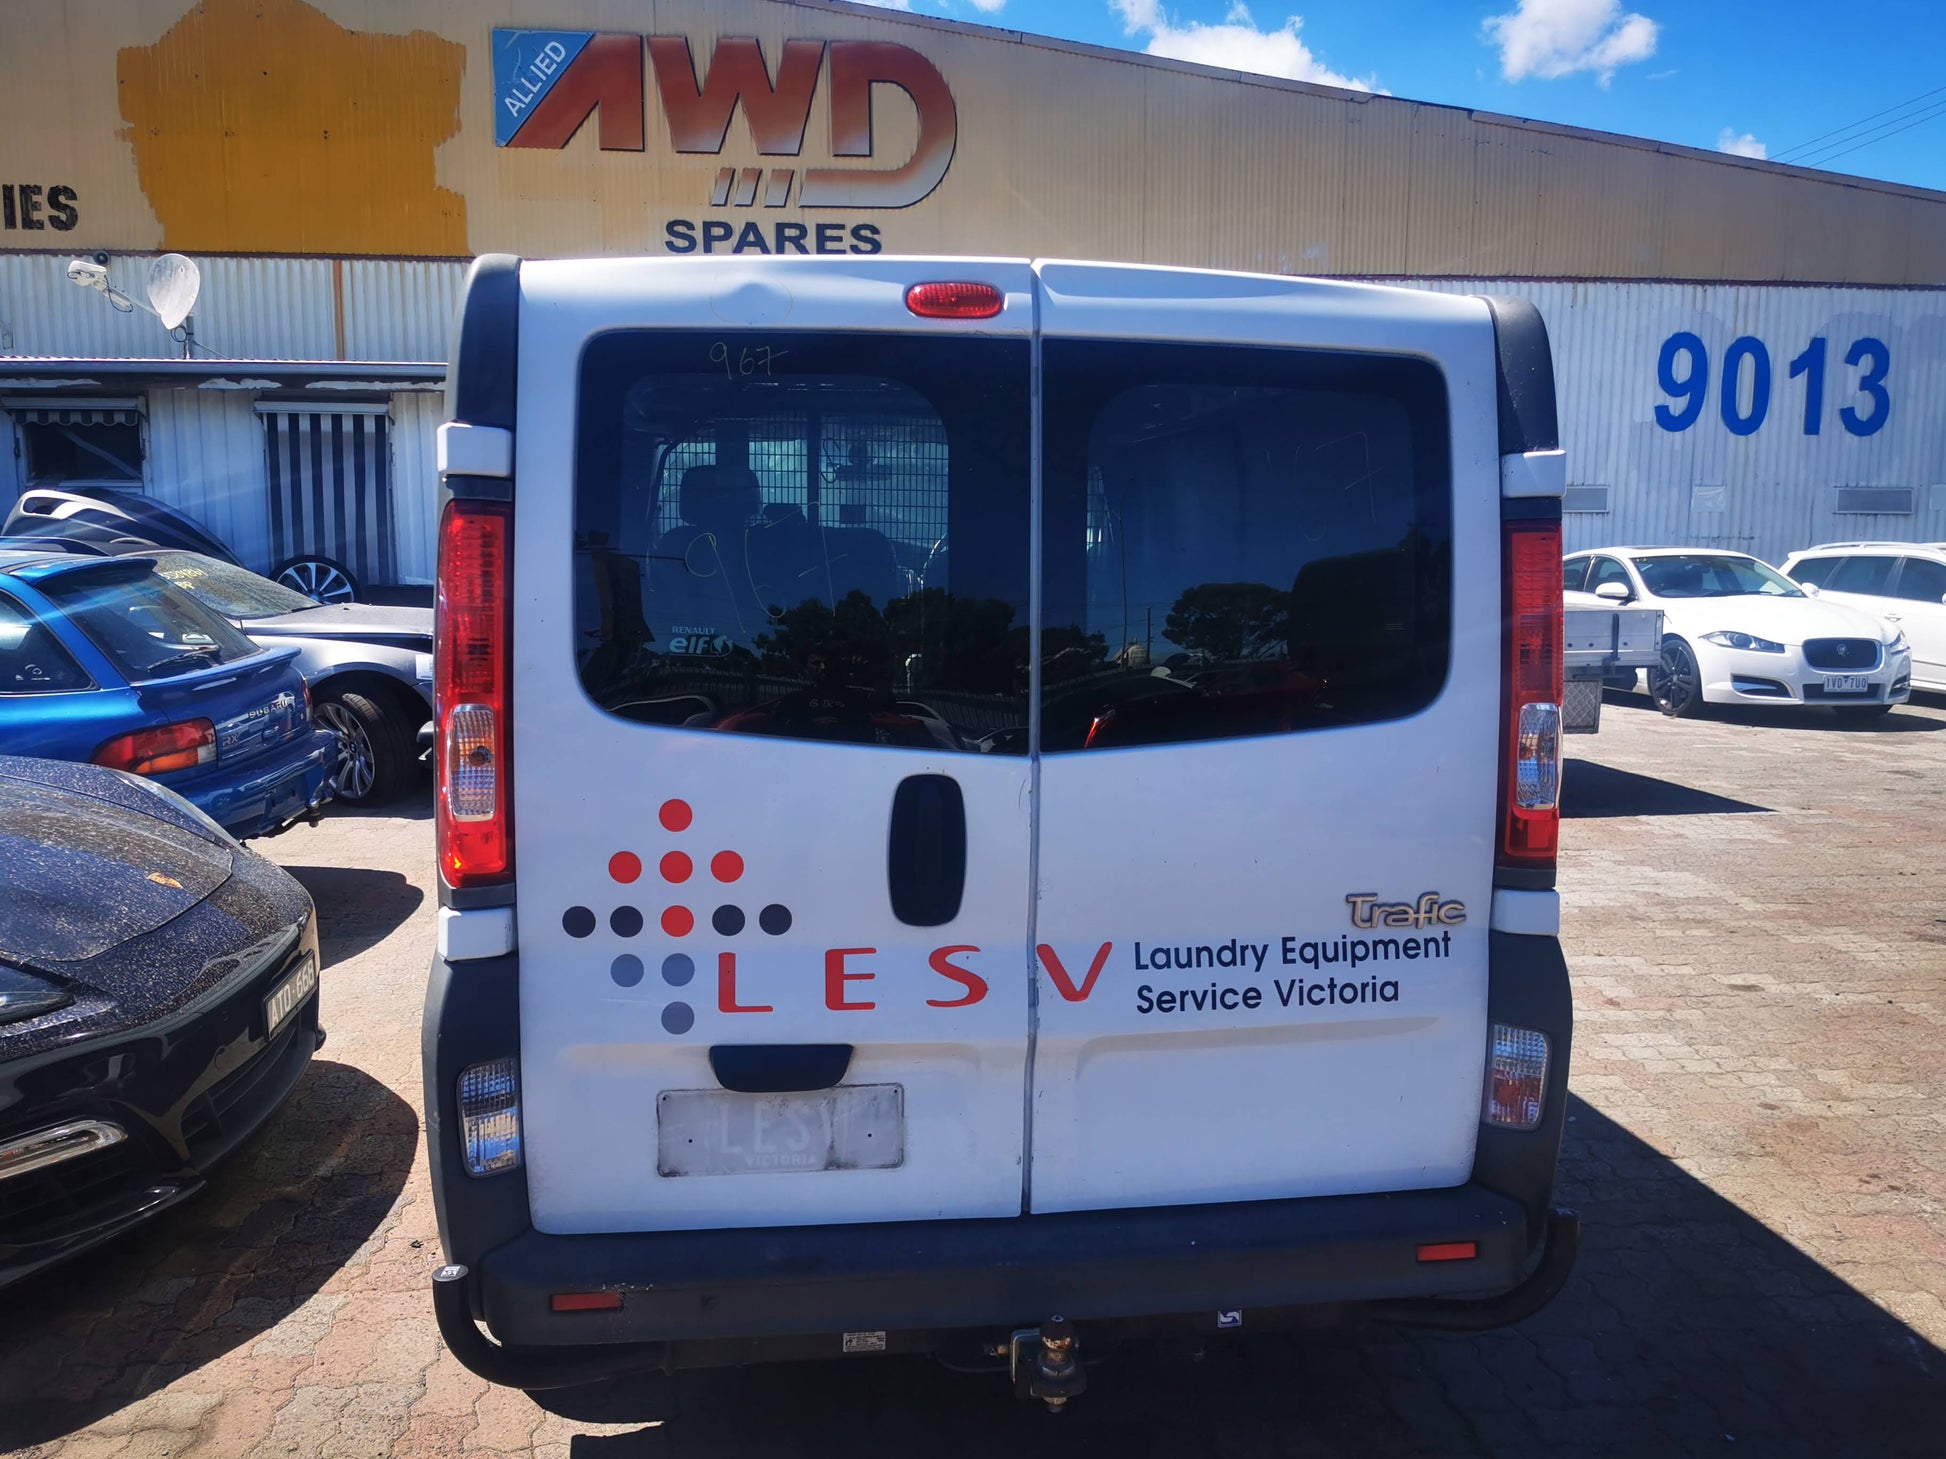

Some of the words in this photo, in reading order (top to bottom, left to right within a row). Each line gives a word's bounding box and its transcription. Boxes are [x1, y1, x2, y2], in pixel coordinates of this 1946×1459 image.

[504, 41, 566, 118] ALLIED
[505, 33, 958, 209] AWD
[664, 219, 883, 255] SPARES
[709, 341, 790, 381] 967
[1654, 331, 1891, 438] 9013
[672, 625, 716, 635] RENAULT
[248, 699, 289, 719] SUBARU
[1345, 891, 1467, 929] Trafic
[1134, 938, 1269, 973] Laundry
[1281, 930, 1451, 970] Equipment
[1136, 982, 1262, 1014] Service
[1273, 975, 1399, 1007] Victoria
